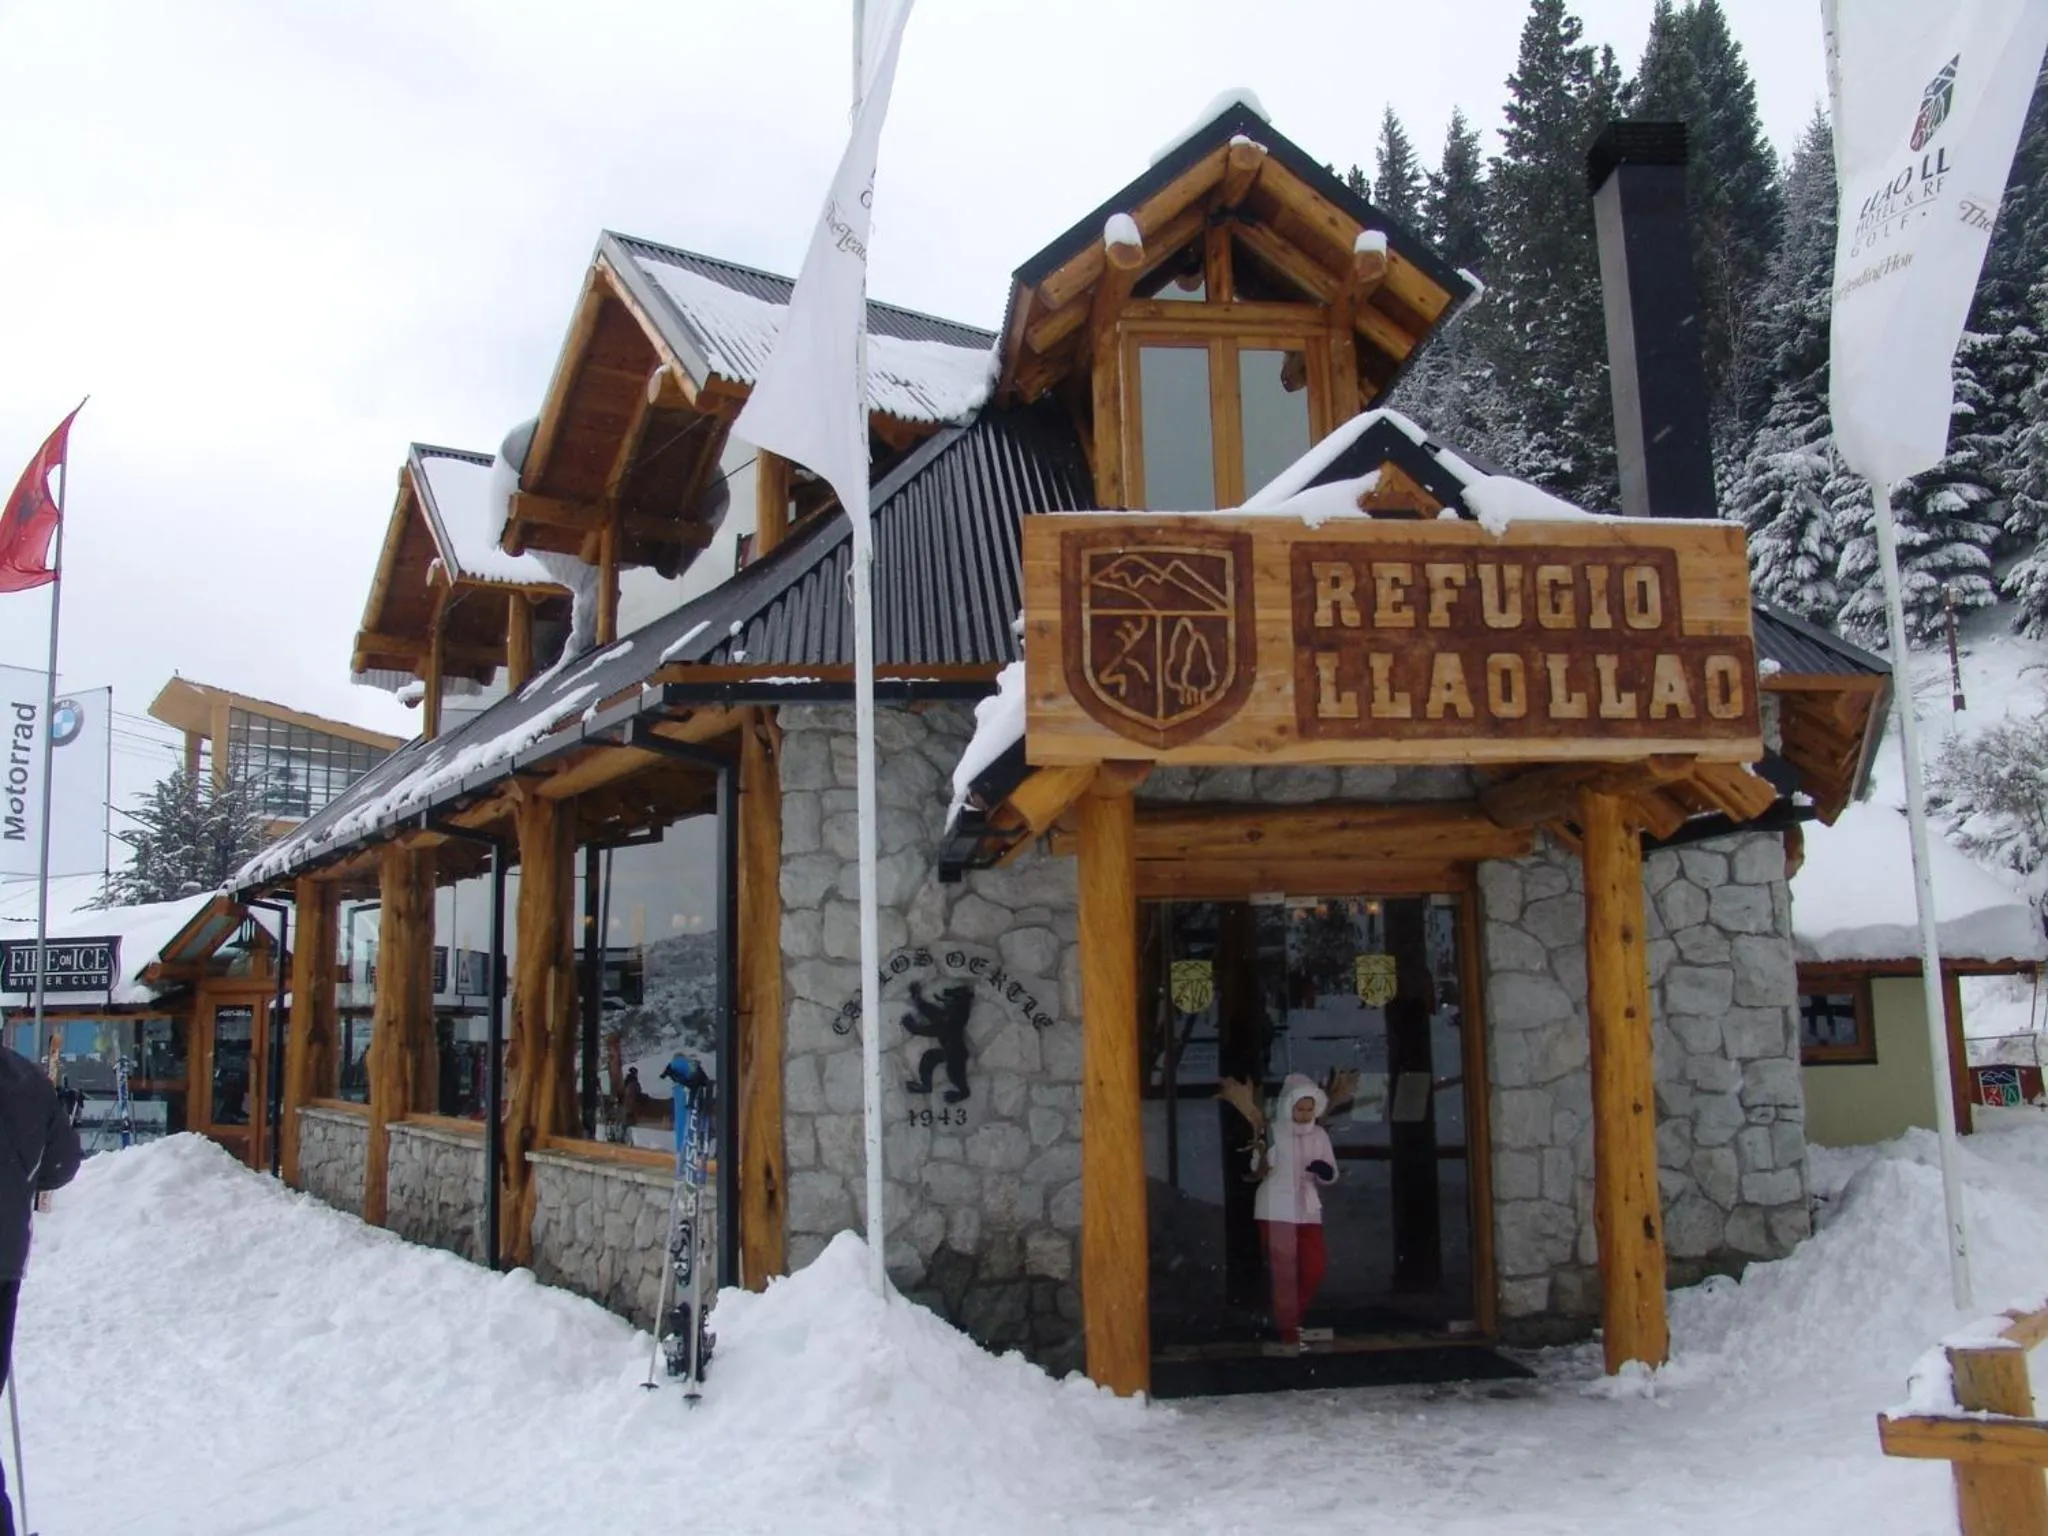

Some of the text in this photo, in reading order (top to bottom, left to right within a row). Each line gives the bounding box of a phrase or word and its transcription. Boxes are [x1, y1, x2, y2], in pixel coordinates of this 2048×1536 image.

[1860, 166, 1913, 220] LLAO
[1311, 561, 1662, 630] REFUGIO
[1314, 651, 1745, 720] LLAOLLAO
[4, 702, 36, 841] Motorrad
[9, 975, 108, 986] WINER CLUB
[60, 955, 72, 966] ON
[72, 947, 108, 970] ICE
[908, 1108, 967, 1127] 1943
